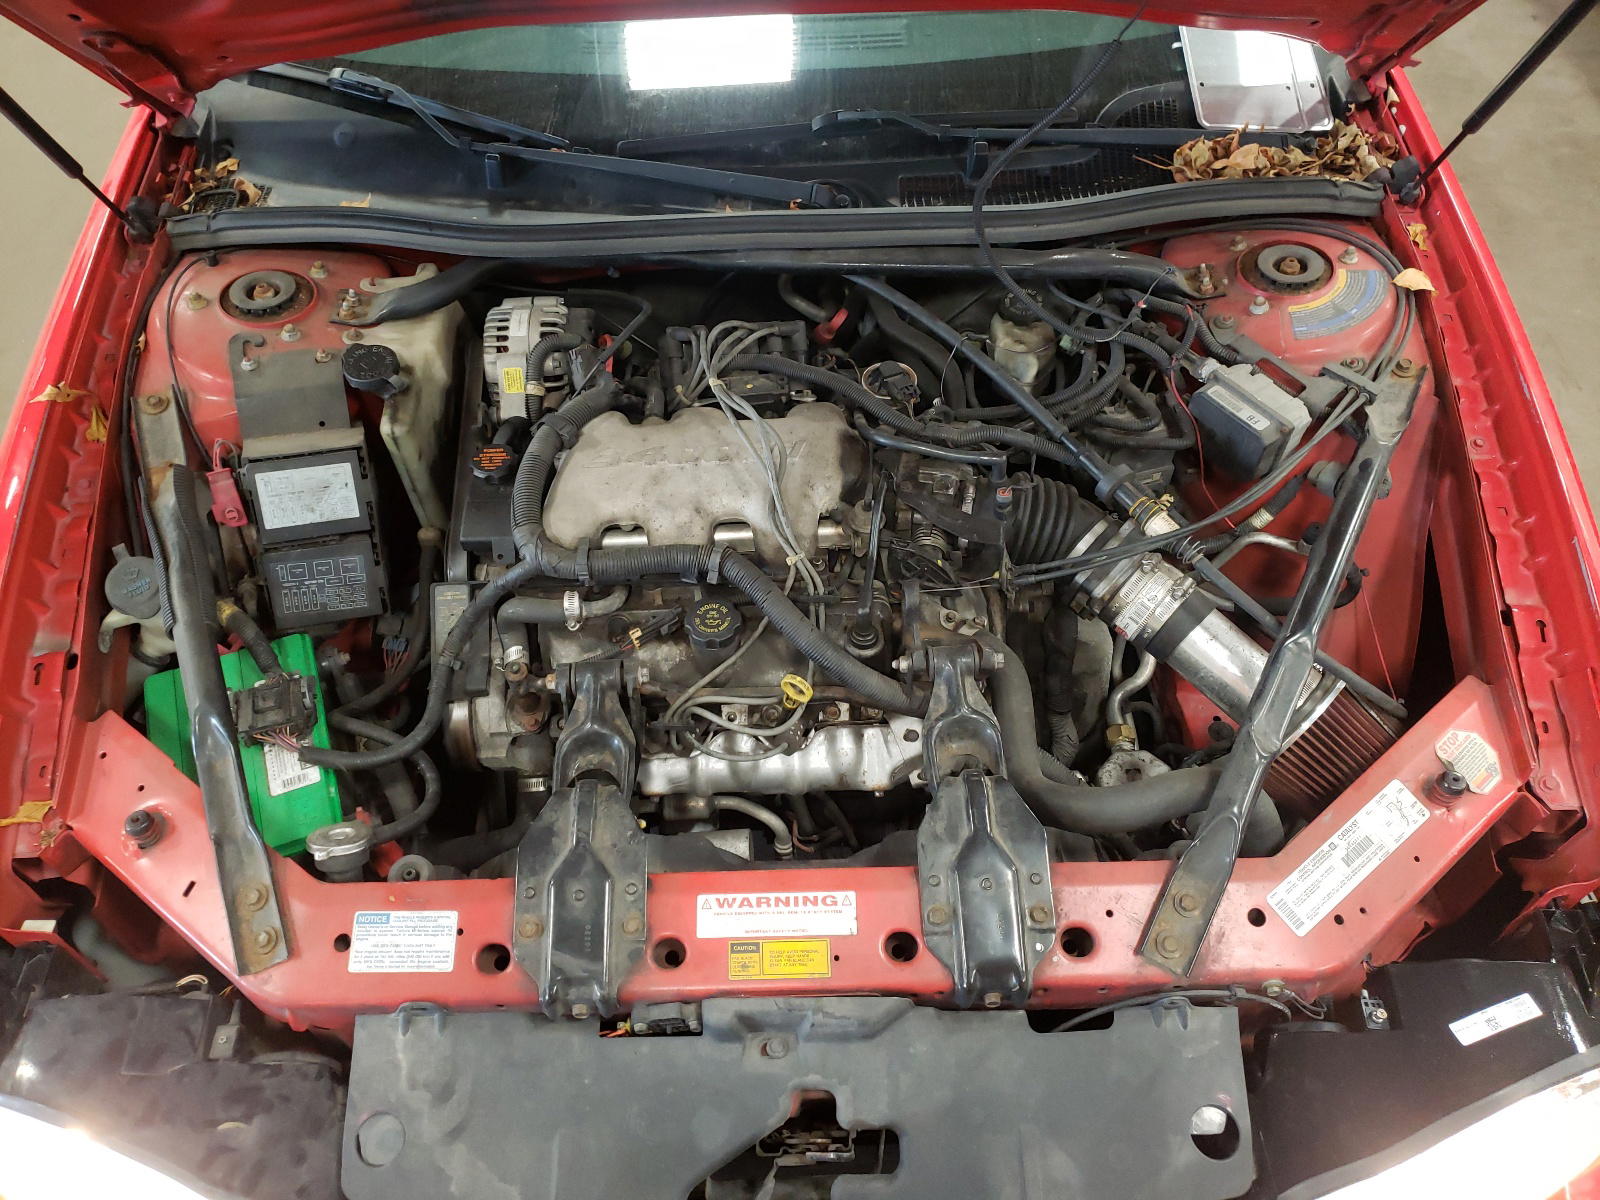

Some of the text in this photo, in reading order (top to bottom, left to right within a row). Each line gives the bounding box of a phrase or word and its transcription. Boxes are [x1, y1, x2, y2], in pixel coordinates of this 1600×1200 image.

[1438, 732, 1460, 755] STOP
[1337, 819, 1360, 841] CATALYST
[715, 895, 839, 909] WARNING
[357, 915, 388, 923] NOTICE
